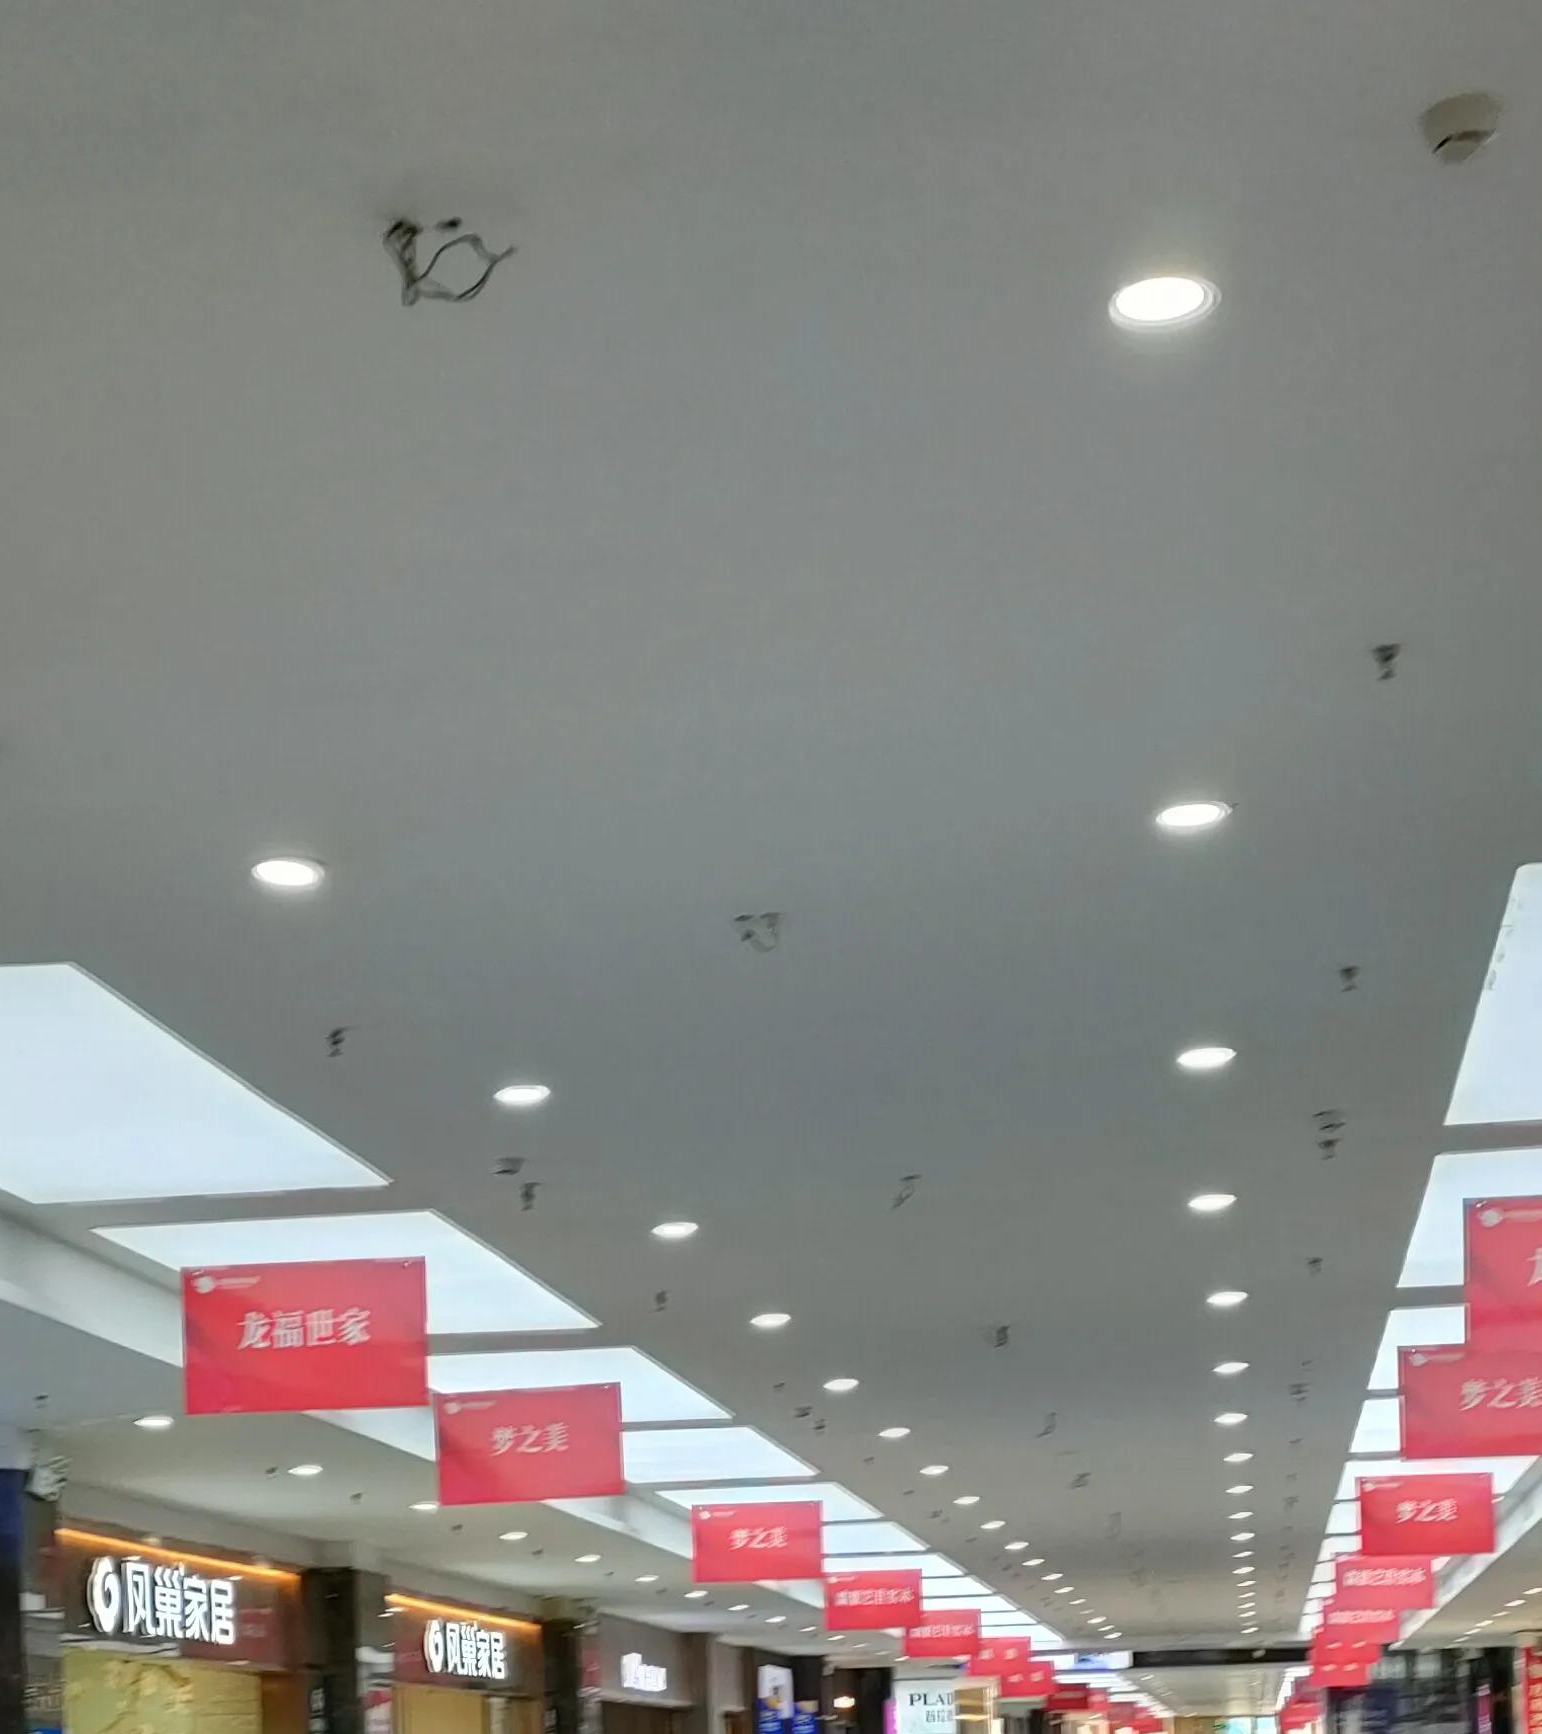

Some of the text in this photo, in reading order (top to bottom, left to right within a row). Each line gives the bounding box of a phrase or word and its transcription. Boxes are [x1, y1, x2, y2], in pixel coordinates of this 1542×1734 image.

[236, 1306, 371, 1350] 龙福世家
[489, 1421, 570, 1456] 梦之美
[1395, 1498, 1459, 1524] 梦之美
[727, 1526, 788, 1550] 梦之美
[121, 1560, 237, 1645] 凤巢家居
[445, 1620, 508, 1680] 凤巢家居
